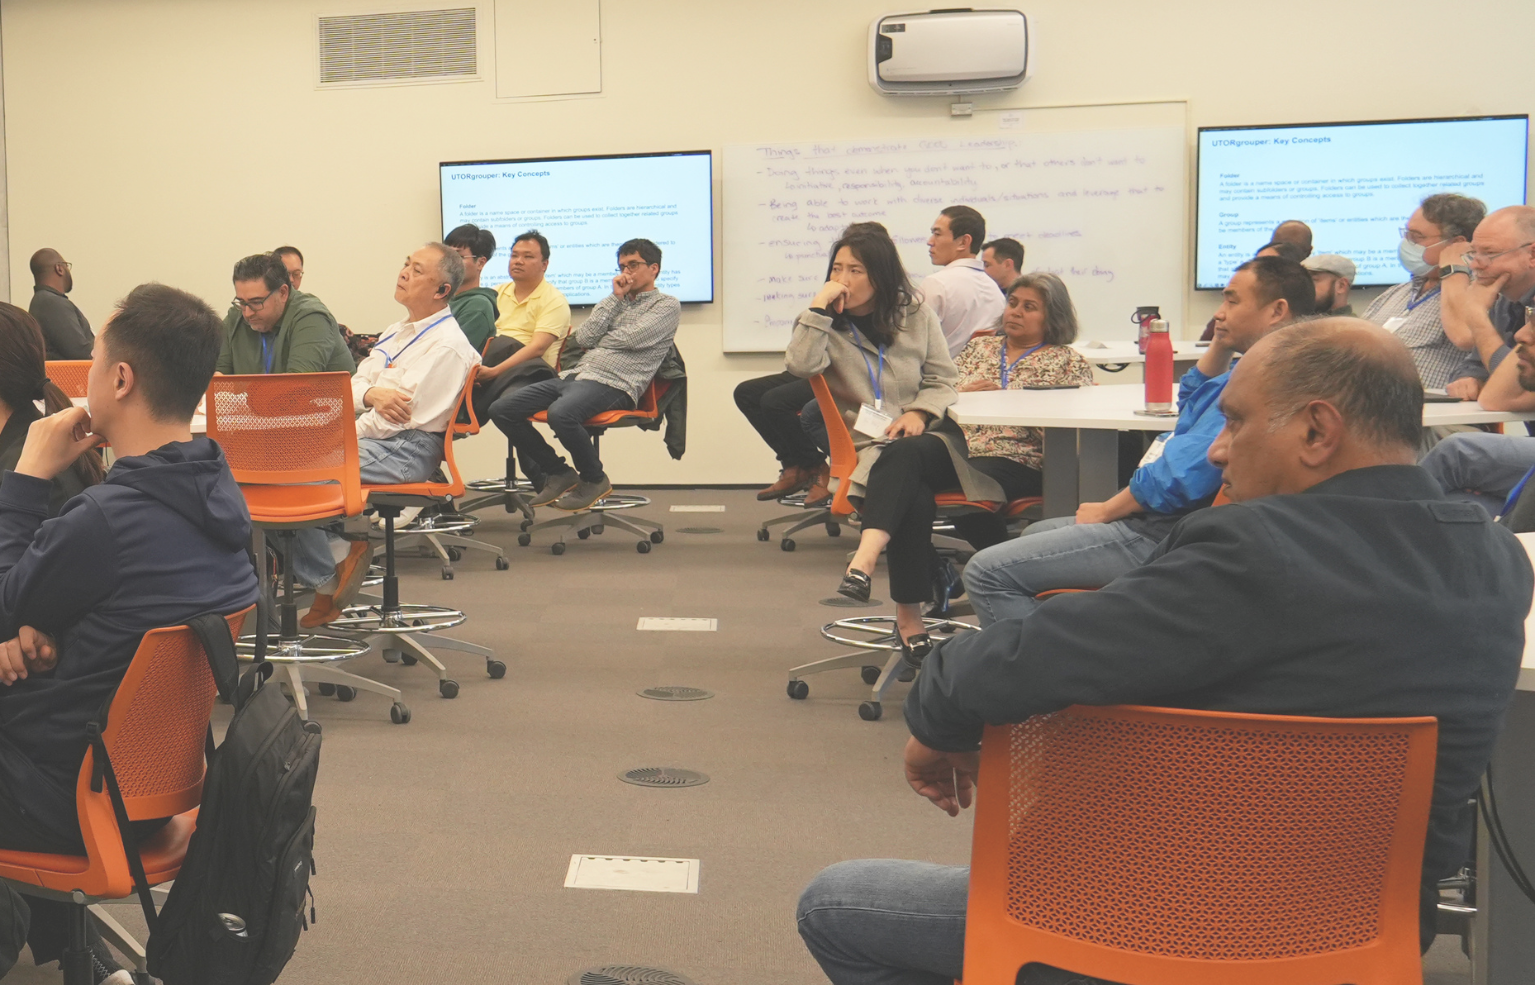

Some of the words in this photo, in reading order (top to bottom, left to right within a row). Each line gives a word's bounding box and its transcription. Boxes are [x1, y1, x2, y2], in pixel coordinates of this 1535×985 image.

[1273, 137, 1289, 145] Key
[1291, 136, 1331, 144] Concepts
[502, 171, 516, 179] Key
[517, 170, 551, 178] Concepts
